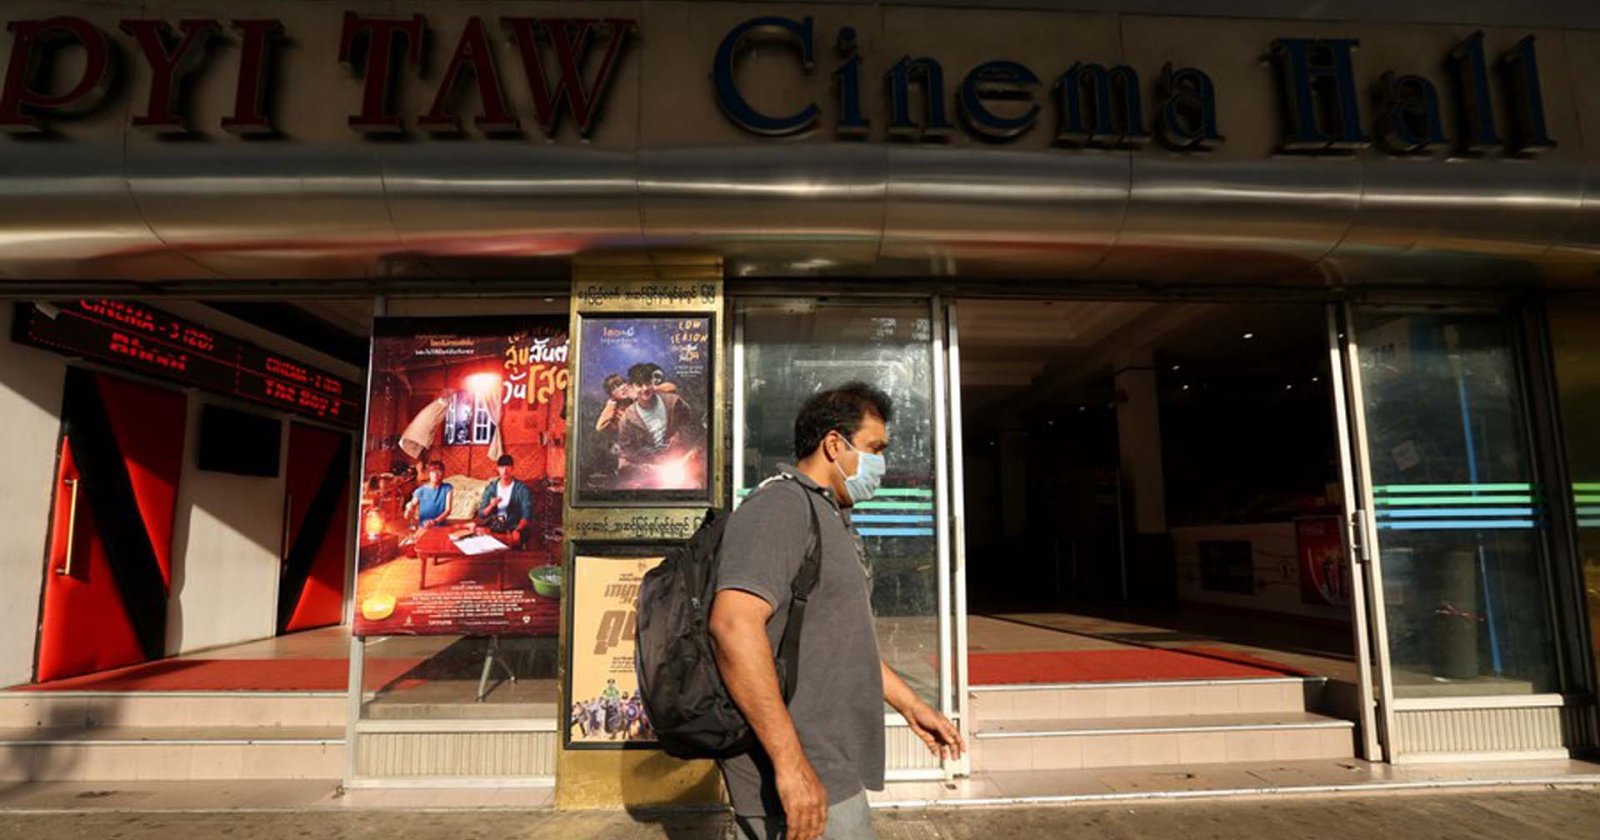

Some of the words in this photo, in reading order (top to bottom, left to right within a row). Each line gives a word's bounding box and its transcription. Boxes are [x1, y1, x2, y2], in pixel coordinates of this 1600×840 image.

[0, 17, 285, 133] PYI
[337, 10, 638, 142] TAW
[712, 16, 1224, 148] Cinema
[1266, 29, 1557, 158] Hall
[678, 320, 702, 332] LOW
[670, 332, 709, 345] SEASON
